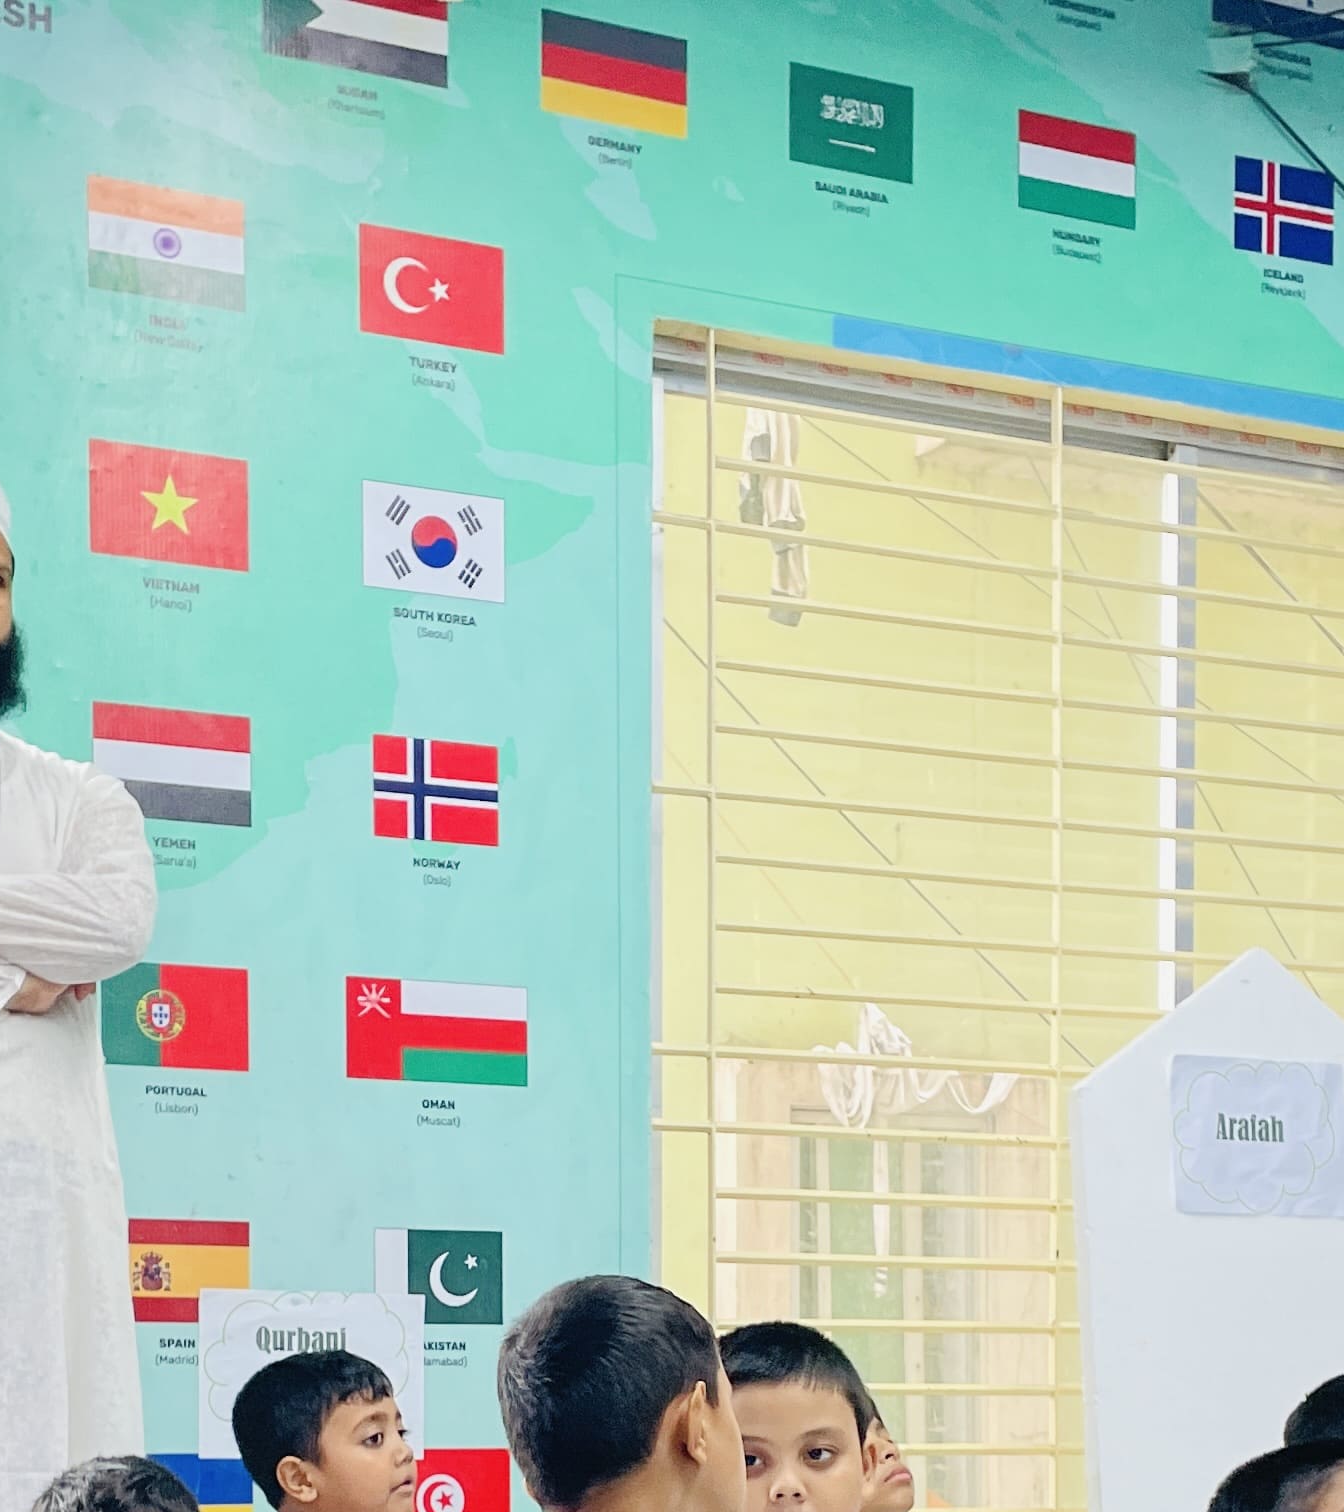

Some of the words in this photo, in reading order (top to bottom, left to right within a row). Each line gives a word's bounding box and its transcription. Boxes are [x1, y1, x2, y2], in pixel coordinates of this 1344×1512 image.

[587, 135, 643, 155] GERMANY
[408, 355, 458, 374] TURKEY
[142, 576, 201, 595] VIETNAM
[149, 593, 193, 613] (Hanoi)
[392, 606, 435, 624] SOUTH
[435, 611, 477, 628] KOREA
[151, 836, 196, 850] YEMEN
[412, 856, 461, 872] NORWAY
[144, 1084, 208, 1099] PORTUGAL
[154, 1100, 199, 1116] (Lisbon)
[421, 1098, 457, 1111] OMAN
[415, 1113, 462, 1130] (Muscat)
[158, 1337, 196, 1351] SPAIN
[256, 1325, 347, 1355] Qurbani
[154, 1353, 199, 1367] (Madrid)
